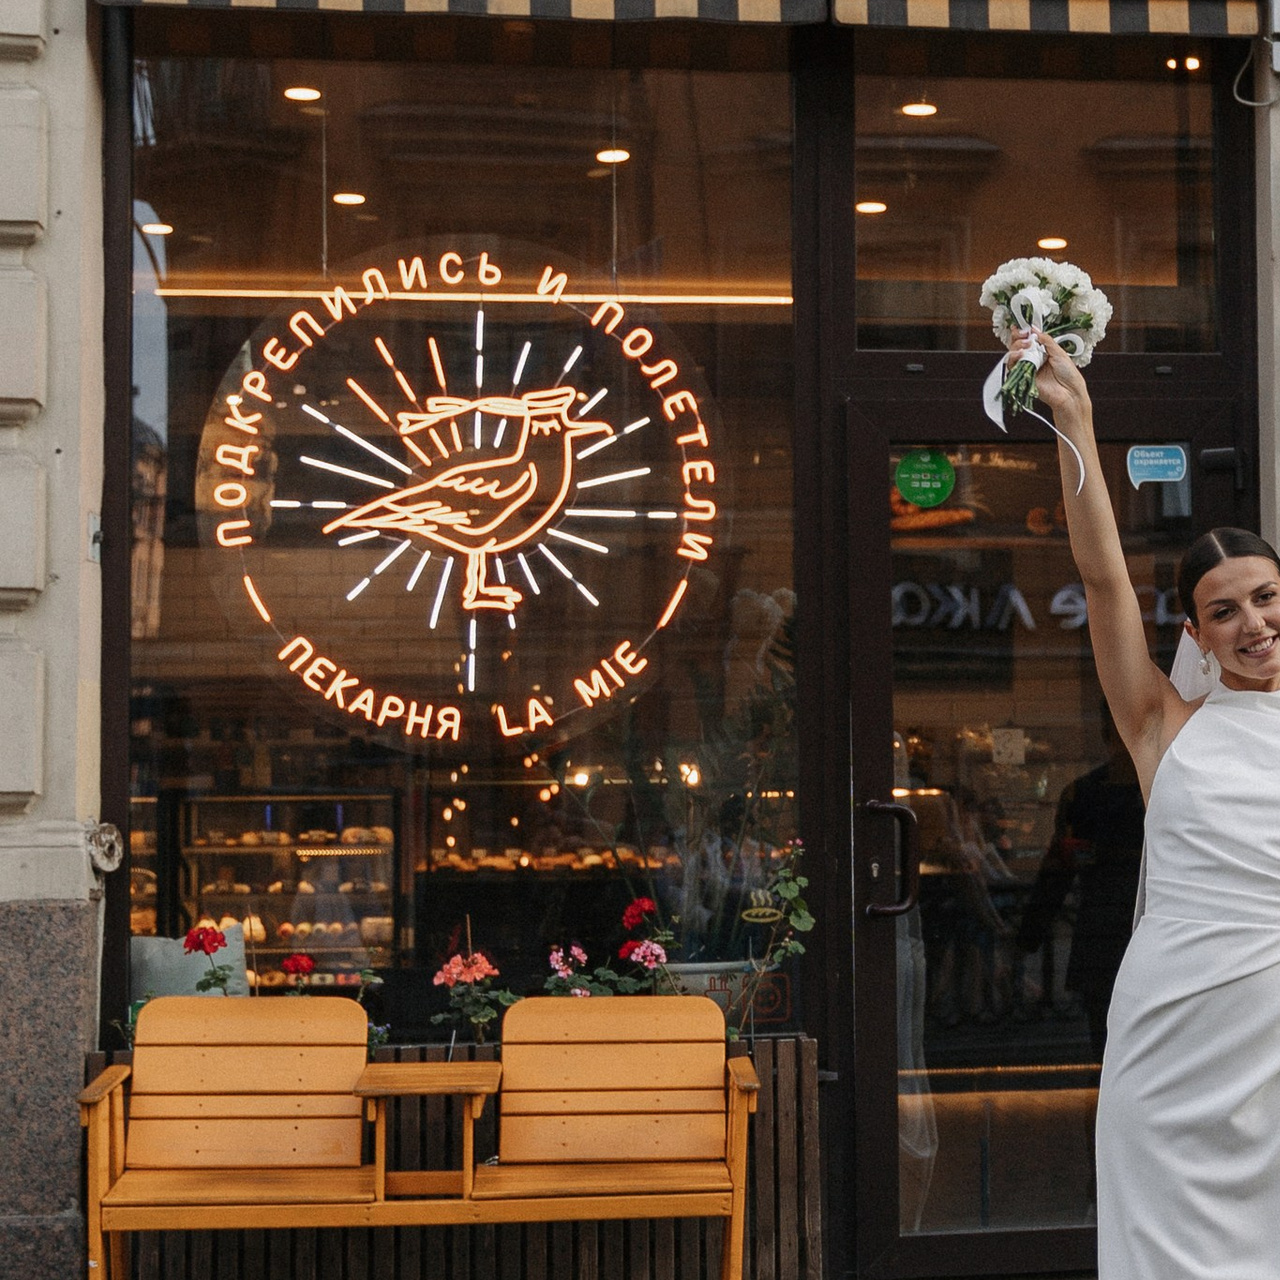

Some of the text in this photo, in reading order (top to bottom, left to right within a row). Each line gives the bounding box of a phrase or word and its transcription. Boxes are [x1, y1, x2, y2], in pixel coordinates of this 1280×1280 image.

[215, 252, 716, 560] ПОДКРЕПИЛИСЬ И ПОЛЕТЕЛИ
[1134, 450, 1164, 458] Объект
[277, 636, 462, 741] ПЕКАРНЯ
[496, 640, 648, 737] LA MIE
